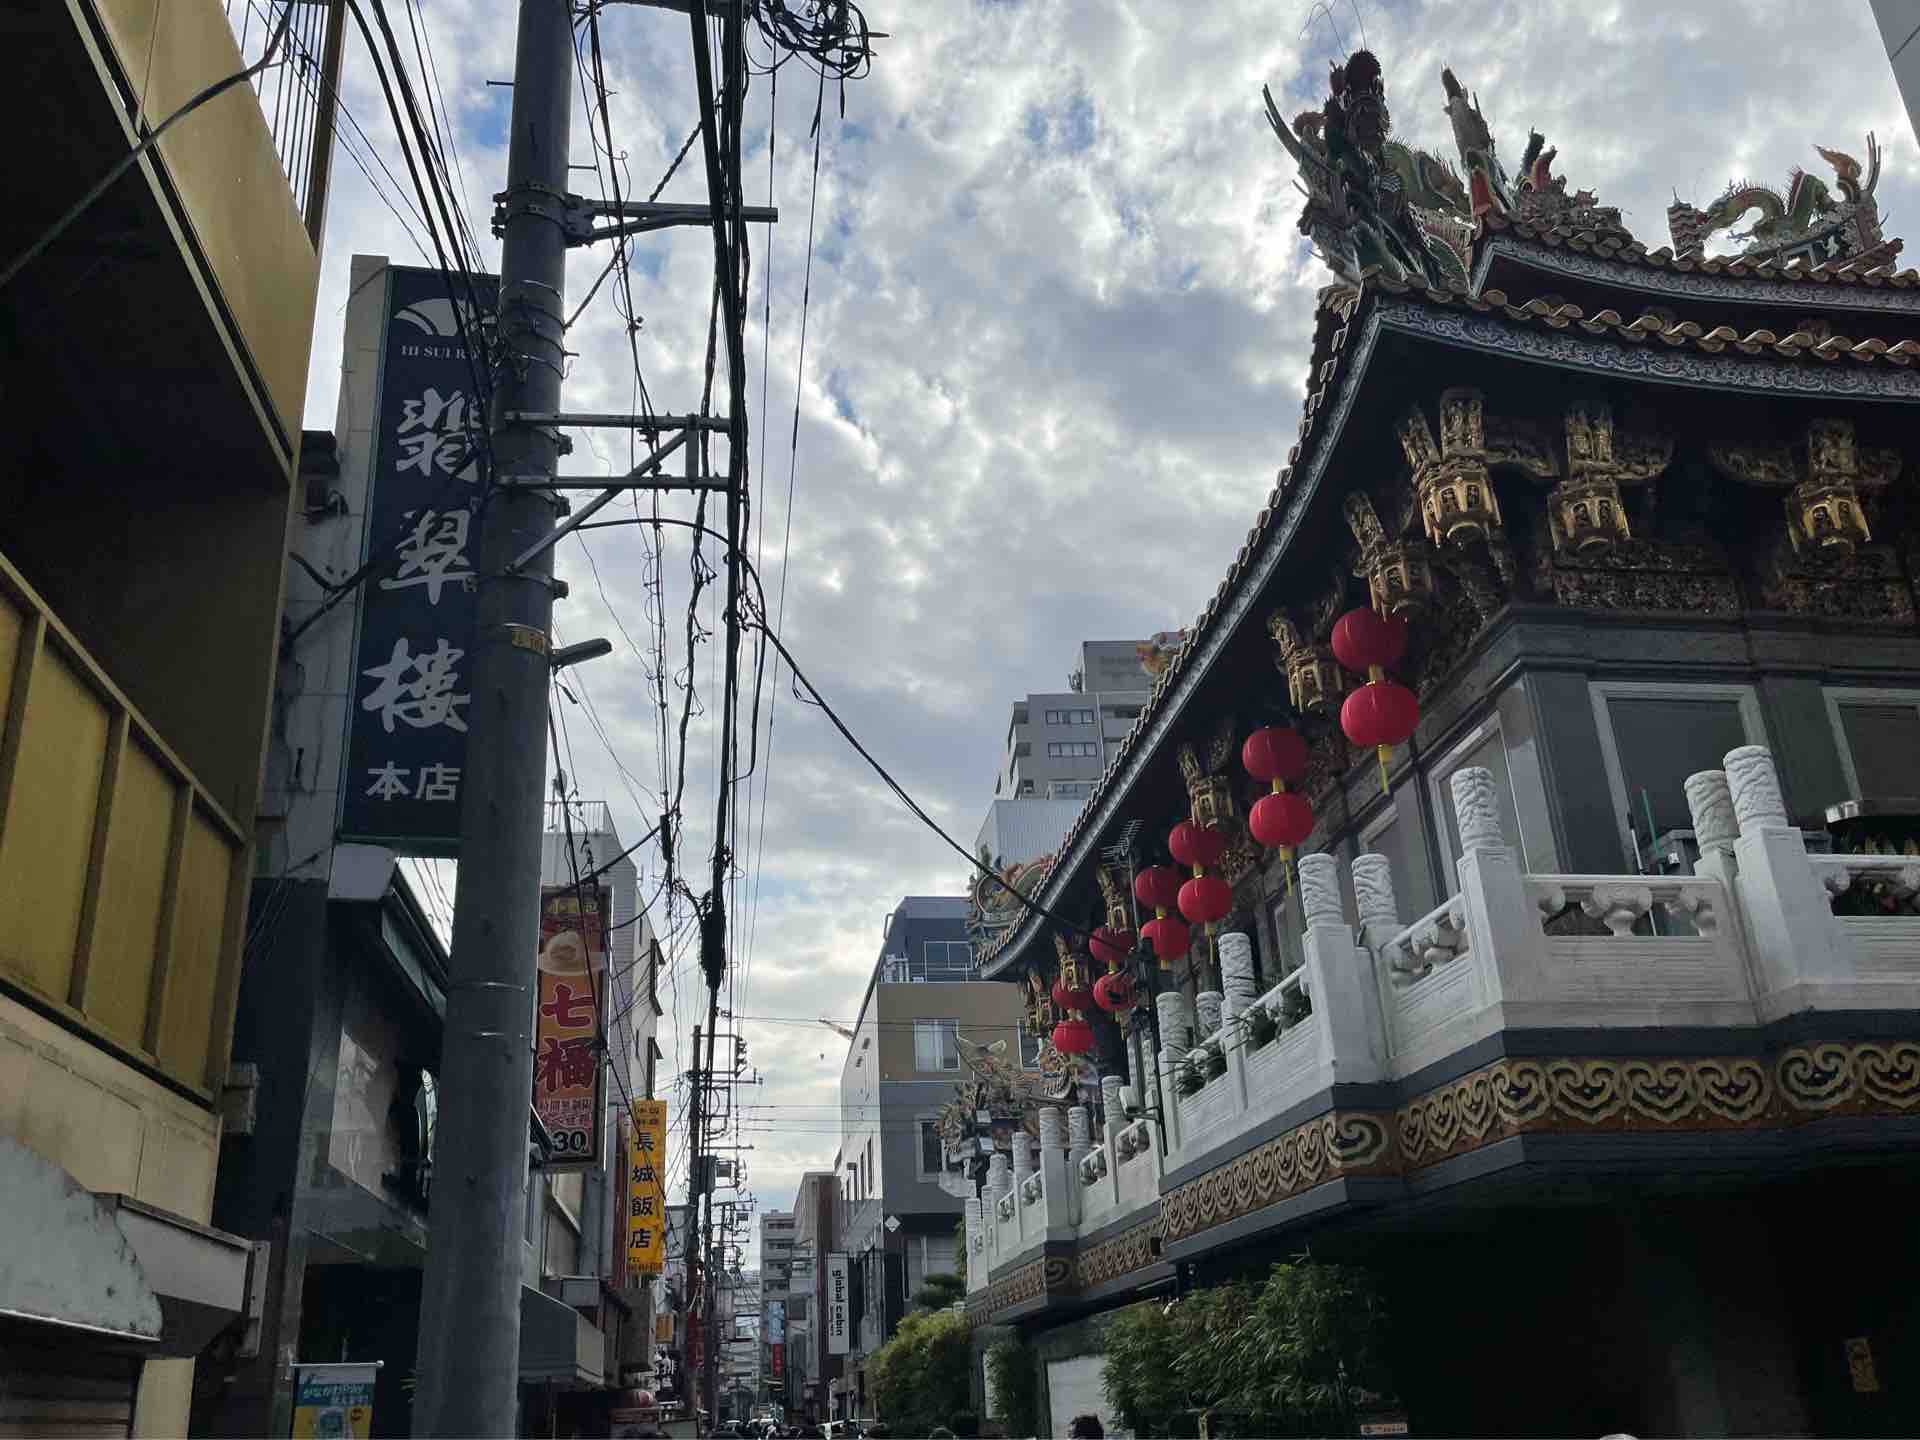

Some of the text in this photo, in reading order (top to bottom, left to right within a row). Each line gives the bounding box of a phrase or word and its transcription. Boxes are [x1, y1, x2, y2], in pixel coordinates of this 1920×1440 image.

[423, 345, 451, 359] SUI
[365, 760, 461, 801] 本店
[629, 1132, 656, 1249] 長城飯店
[835, 1304, 846, 1337] cabin
